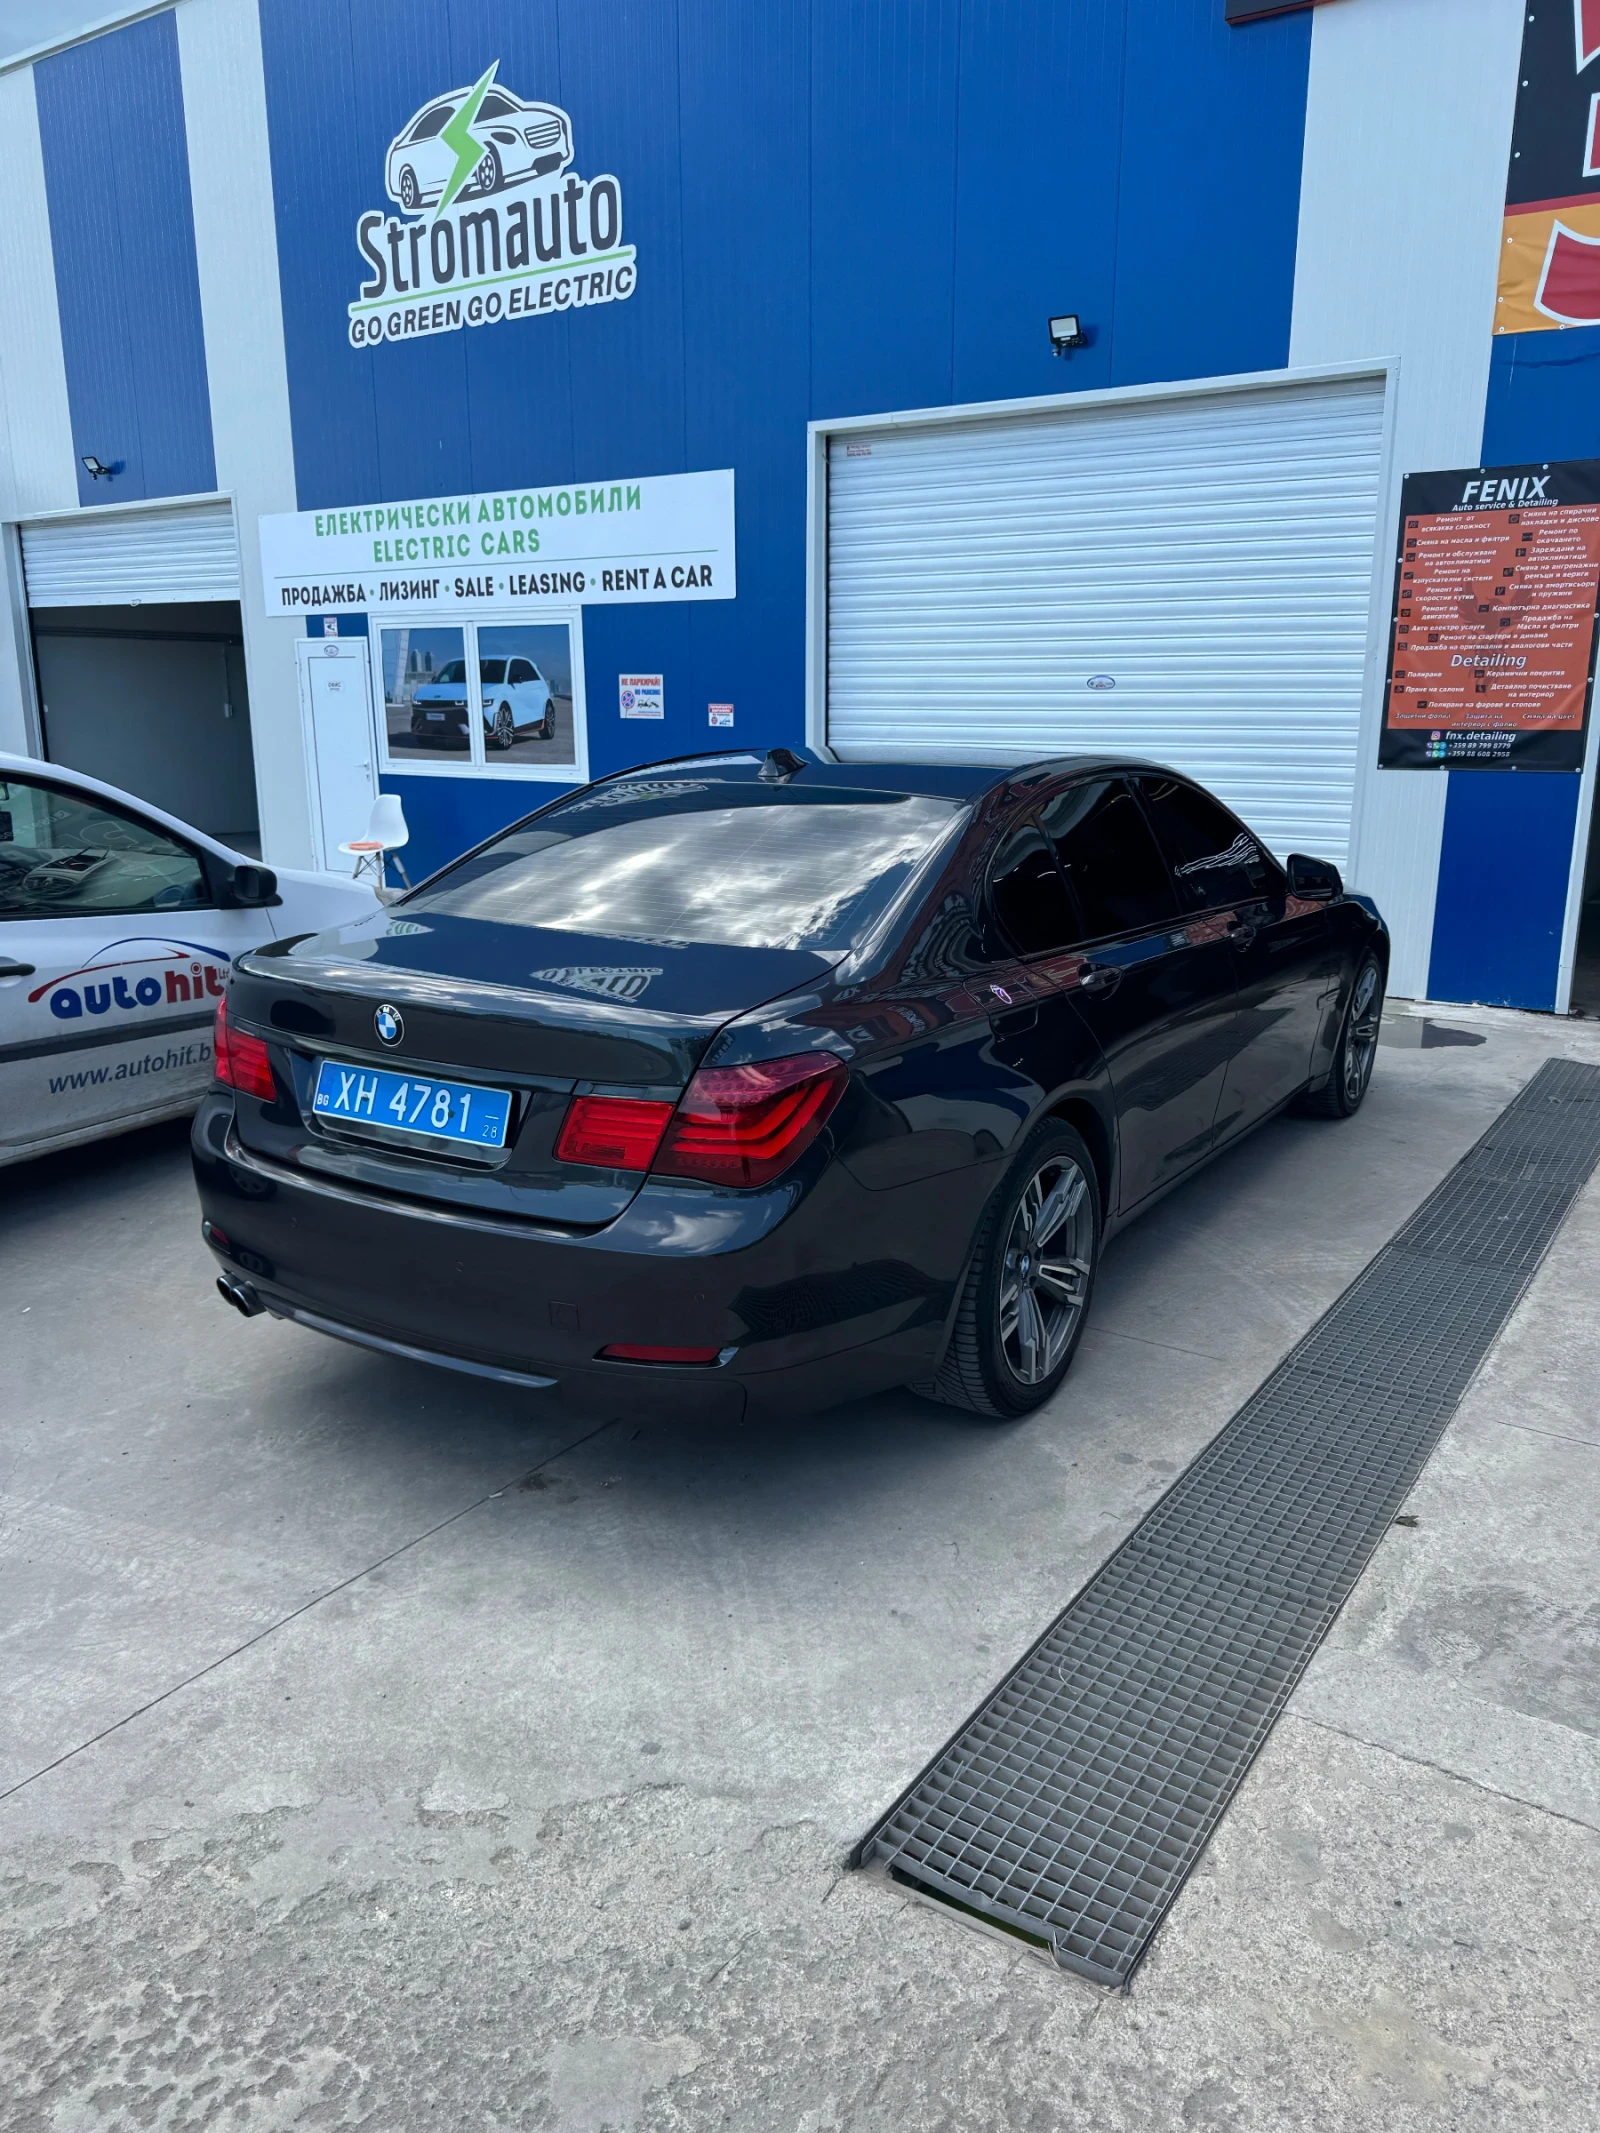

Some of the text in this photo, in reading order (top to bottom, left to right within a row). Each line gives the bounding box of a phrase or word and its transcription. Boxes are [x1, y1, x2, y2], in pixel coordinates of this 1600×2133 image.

[360, 179, 618, 298] Stromauto
[352, 266, 632, 343] GO GREEN GO ELECTRIC
[1452, 504, 1472, 512] Auto
[1475, 502, 1506, 511] service
[1518, 499, 1558, 507] Detailing
[1462, 475, 1551, 503] FENIX
[315, 485, 641, 536] ЕЛЕКТРИЧЕСКИ АВТОМОБИЛИ
[373, 529, 540, 562] ELECTRIC CARS
[281, 564, 713, 606] ПРОДАЖБА ЛИЗИНГ SALE LEASING RENT A CAR
[1450, 654, 1526, 669] Detailing
[1446, 731, 1516, 742] fnx.detailing
[50, 961, 225, 1019] autohit
[375, 1006, 401, 1021] BMW
[48, 1043, 211, 1094] www.autohit.b
[317, 1071, 497, 1139] BG XH 4781 28
